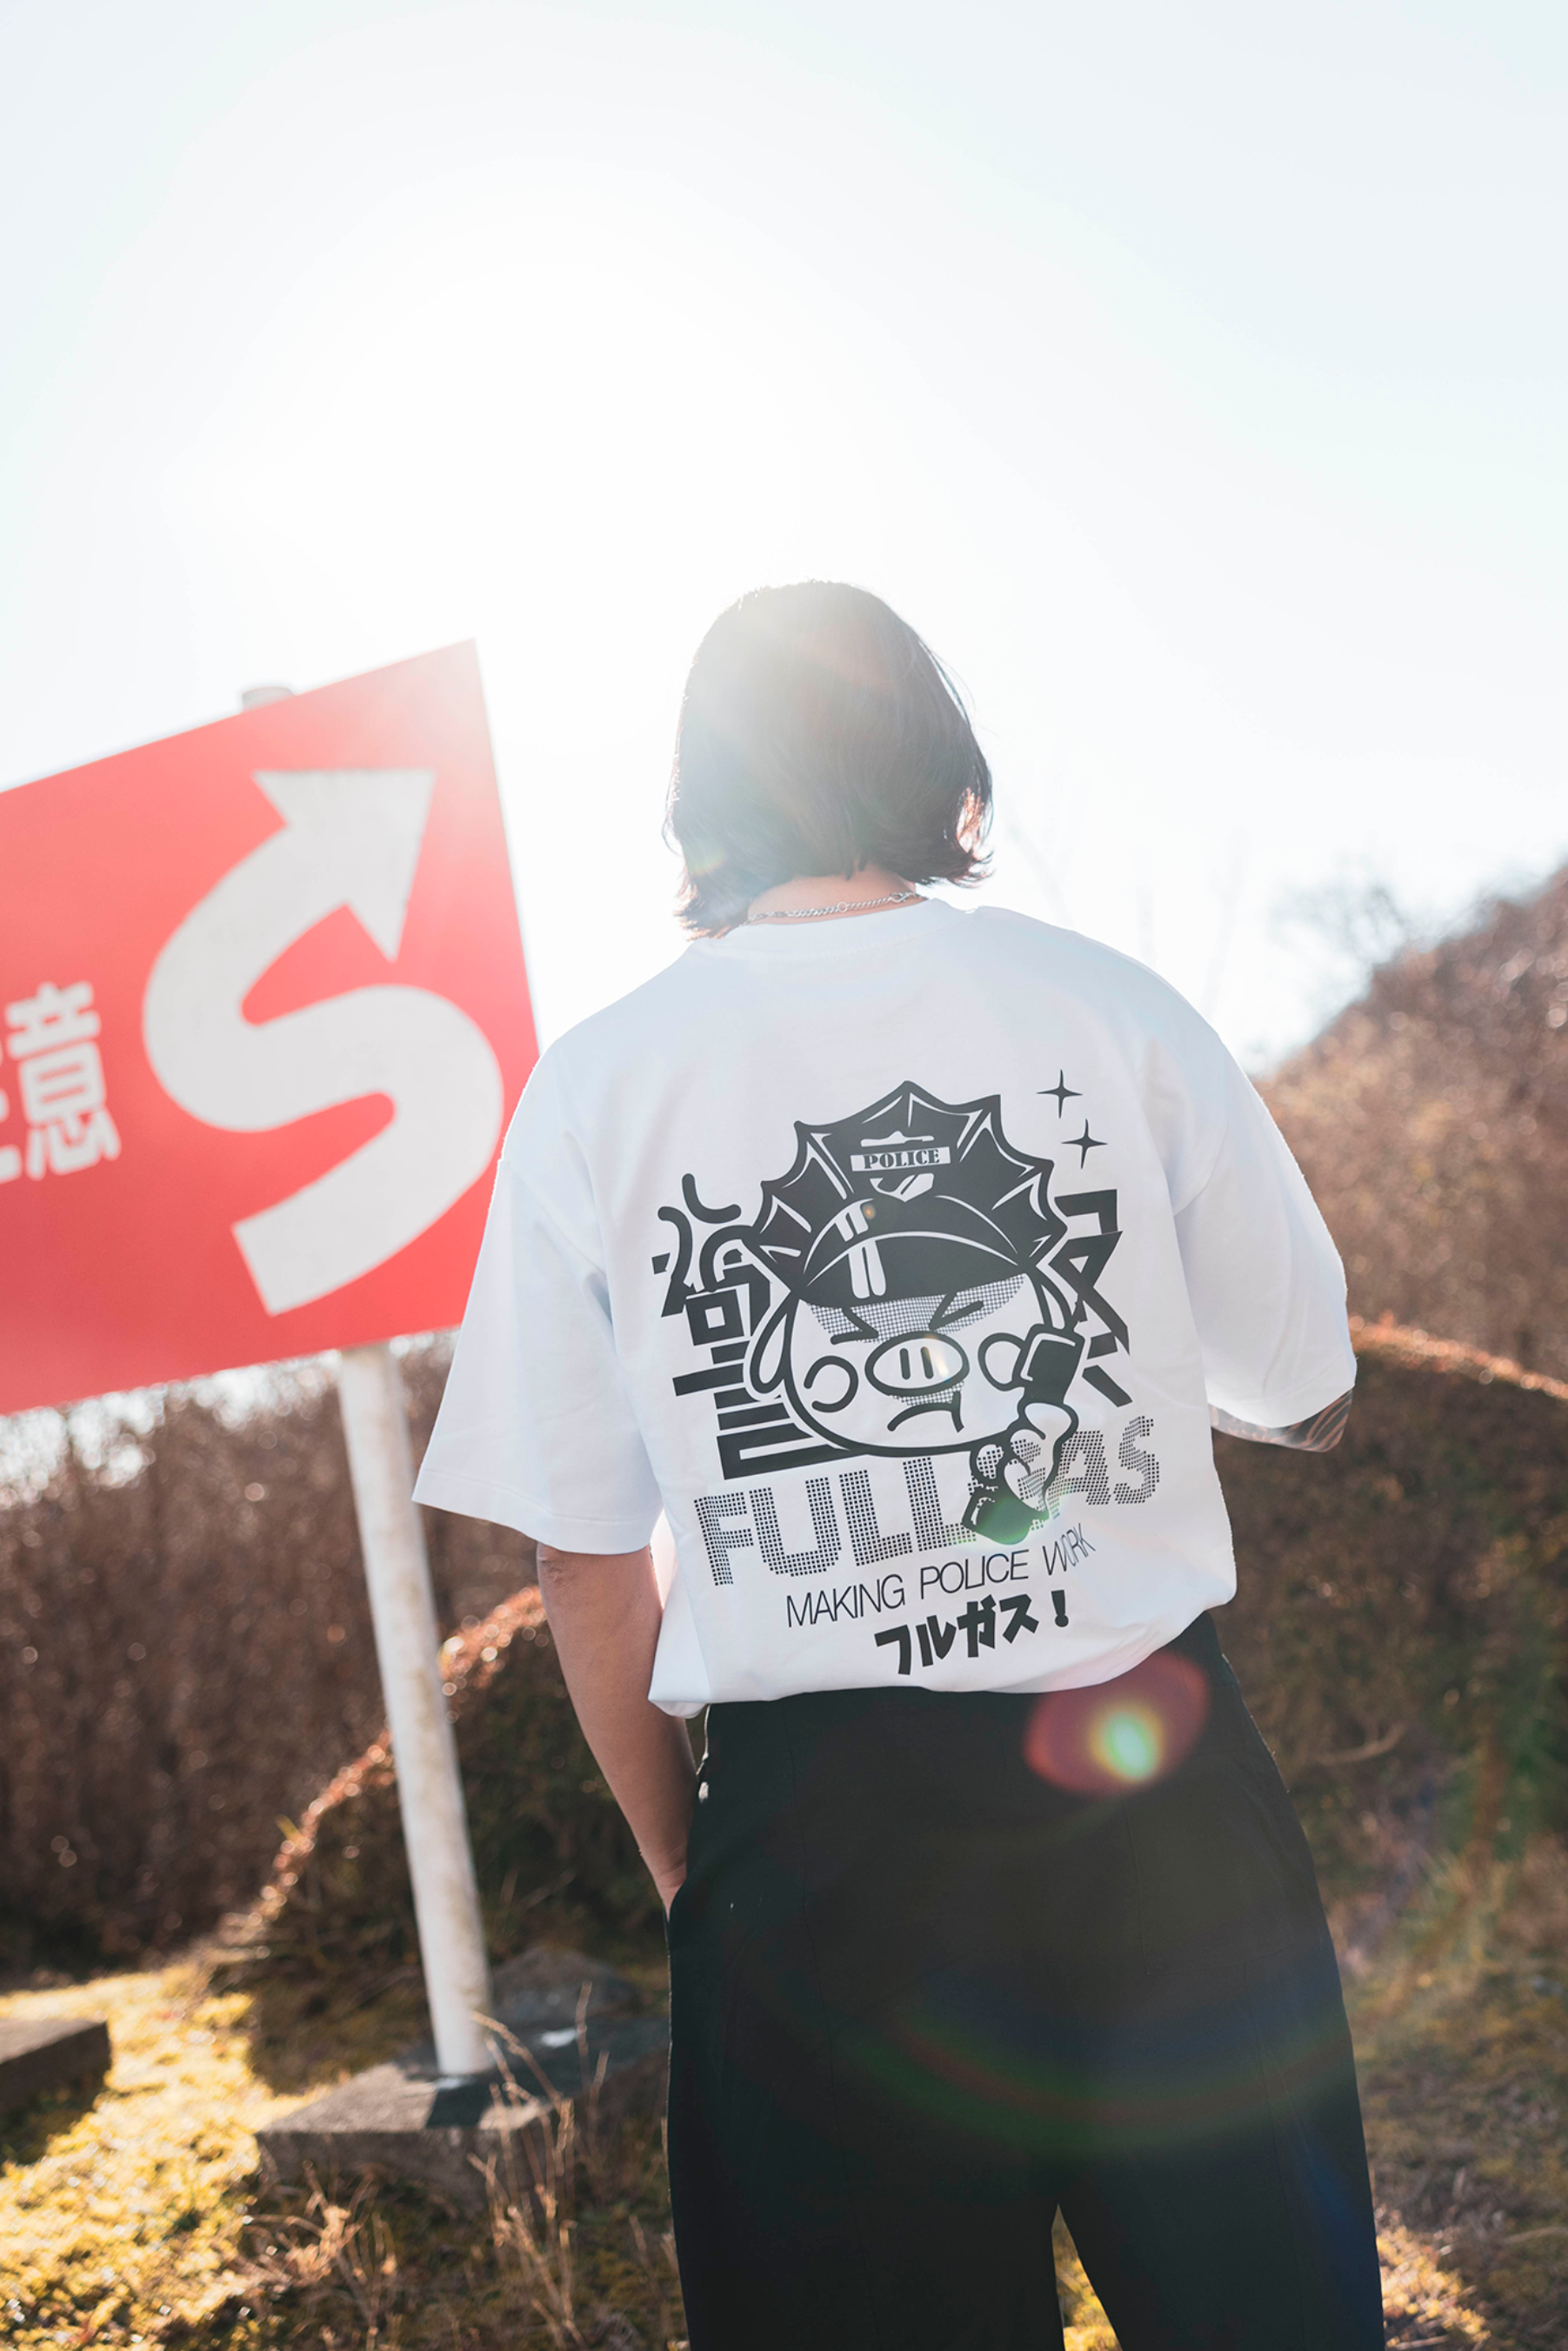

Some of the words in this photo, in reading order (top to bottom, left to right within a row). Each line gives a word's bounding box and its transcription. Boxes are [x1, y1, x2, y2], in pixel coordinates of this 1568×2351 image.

[0, 980, 122, 1184] 意
[863, 1148, 940, 1169] POLICE
[786, 1573, 905, 1627] MAKING
[920, 1549, 1030, 1600] POLICE
[1042, 1522, 1096, 1575] WORK
